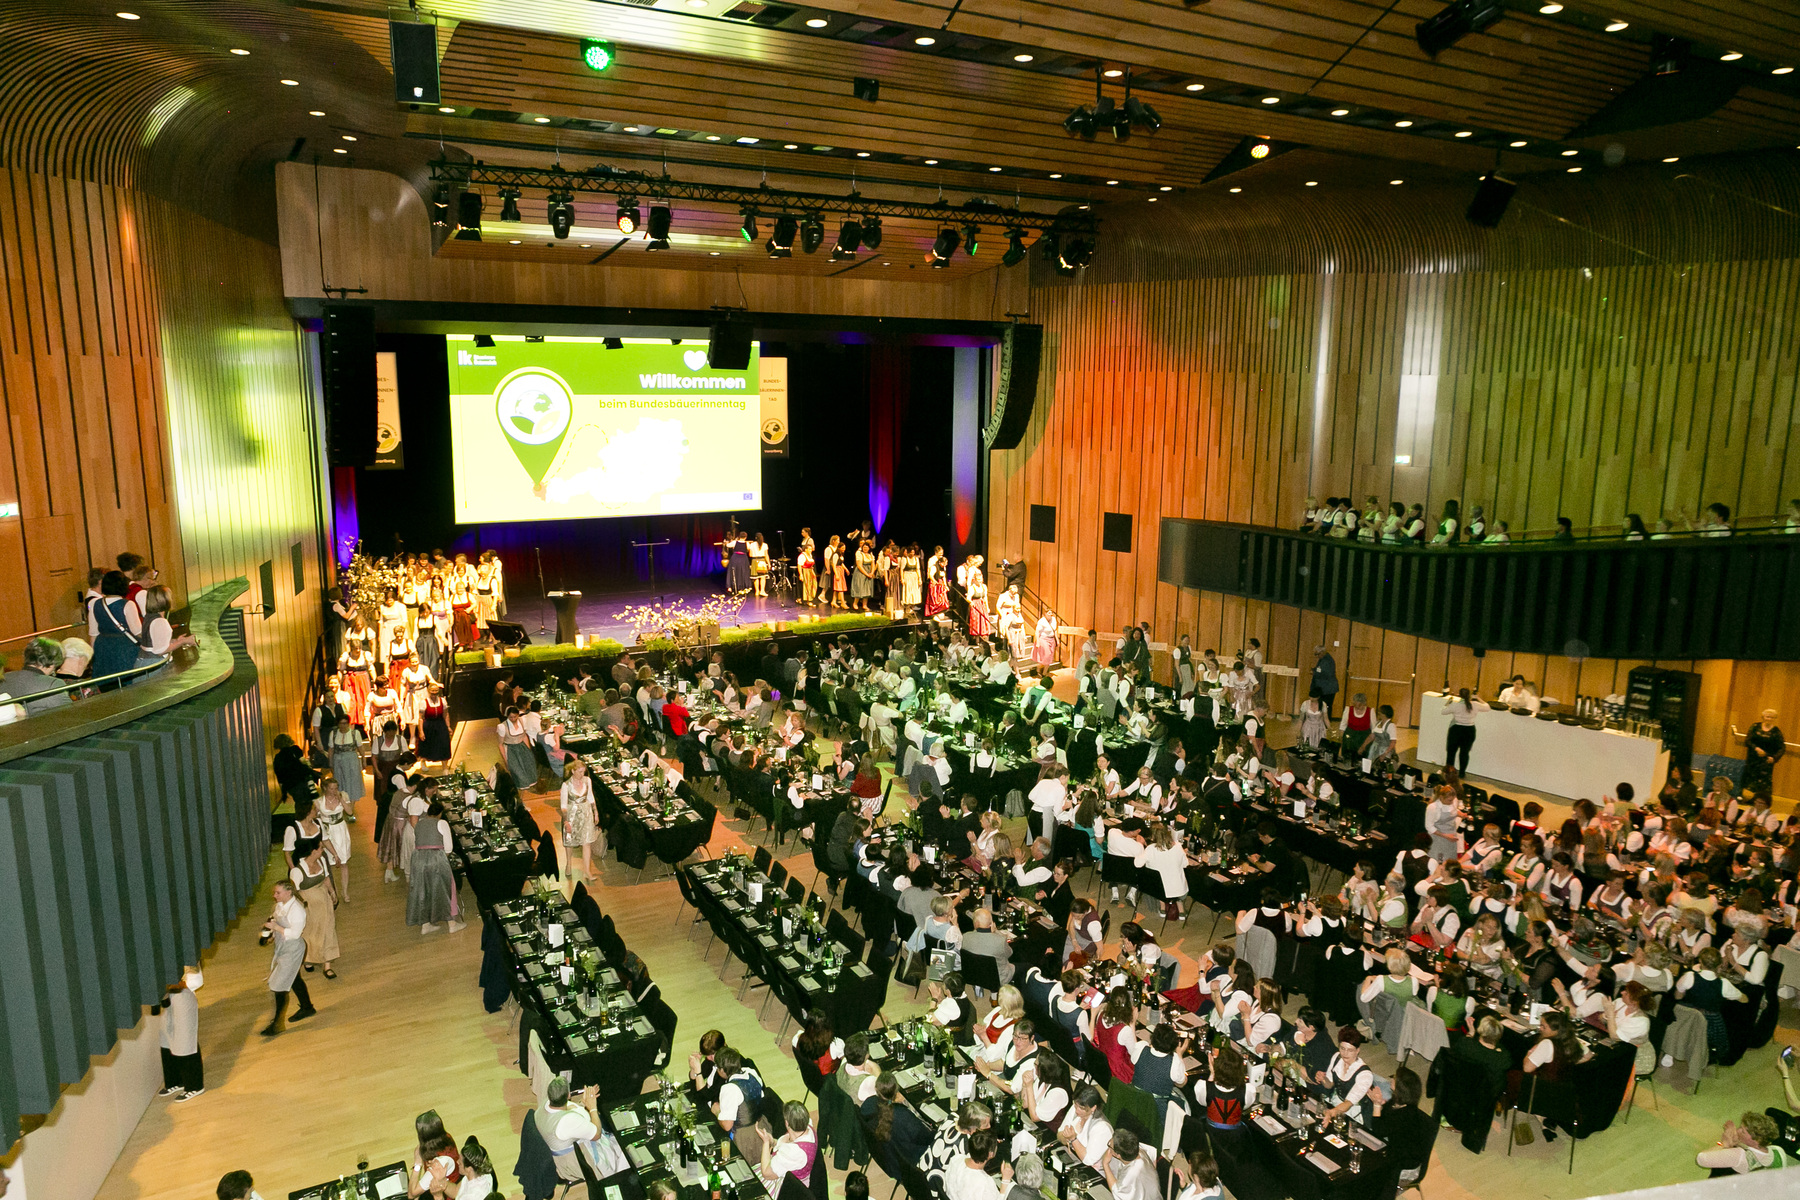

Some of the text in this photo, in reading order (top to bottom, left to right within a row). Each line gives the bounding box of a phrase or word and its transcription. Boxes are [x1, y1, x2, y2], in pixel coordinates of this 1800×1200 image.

[639, 372, 746, 389] Willkommen
[599, 398, 746, 411] beim Bundesbäuerinnentag
